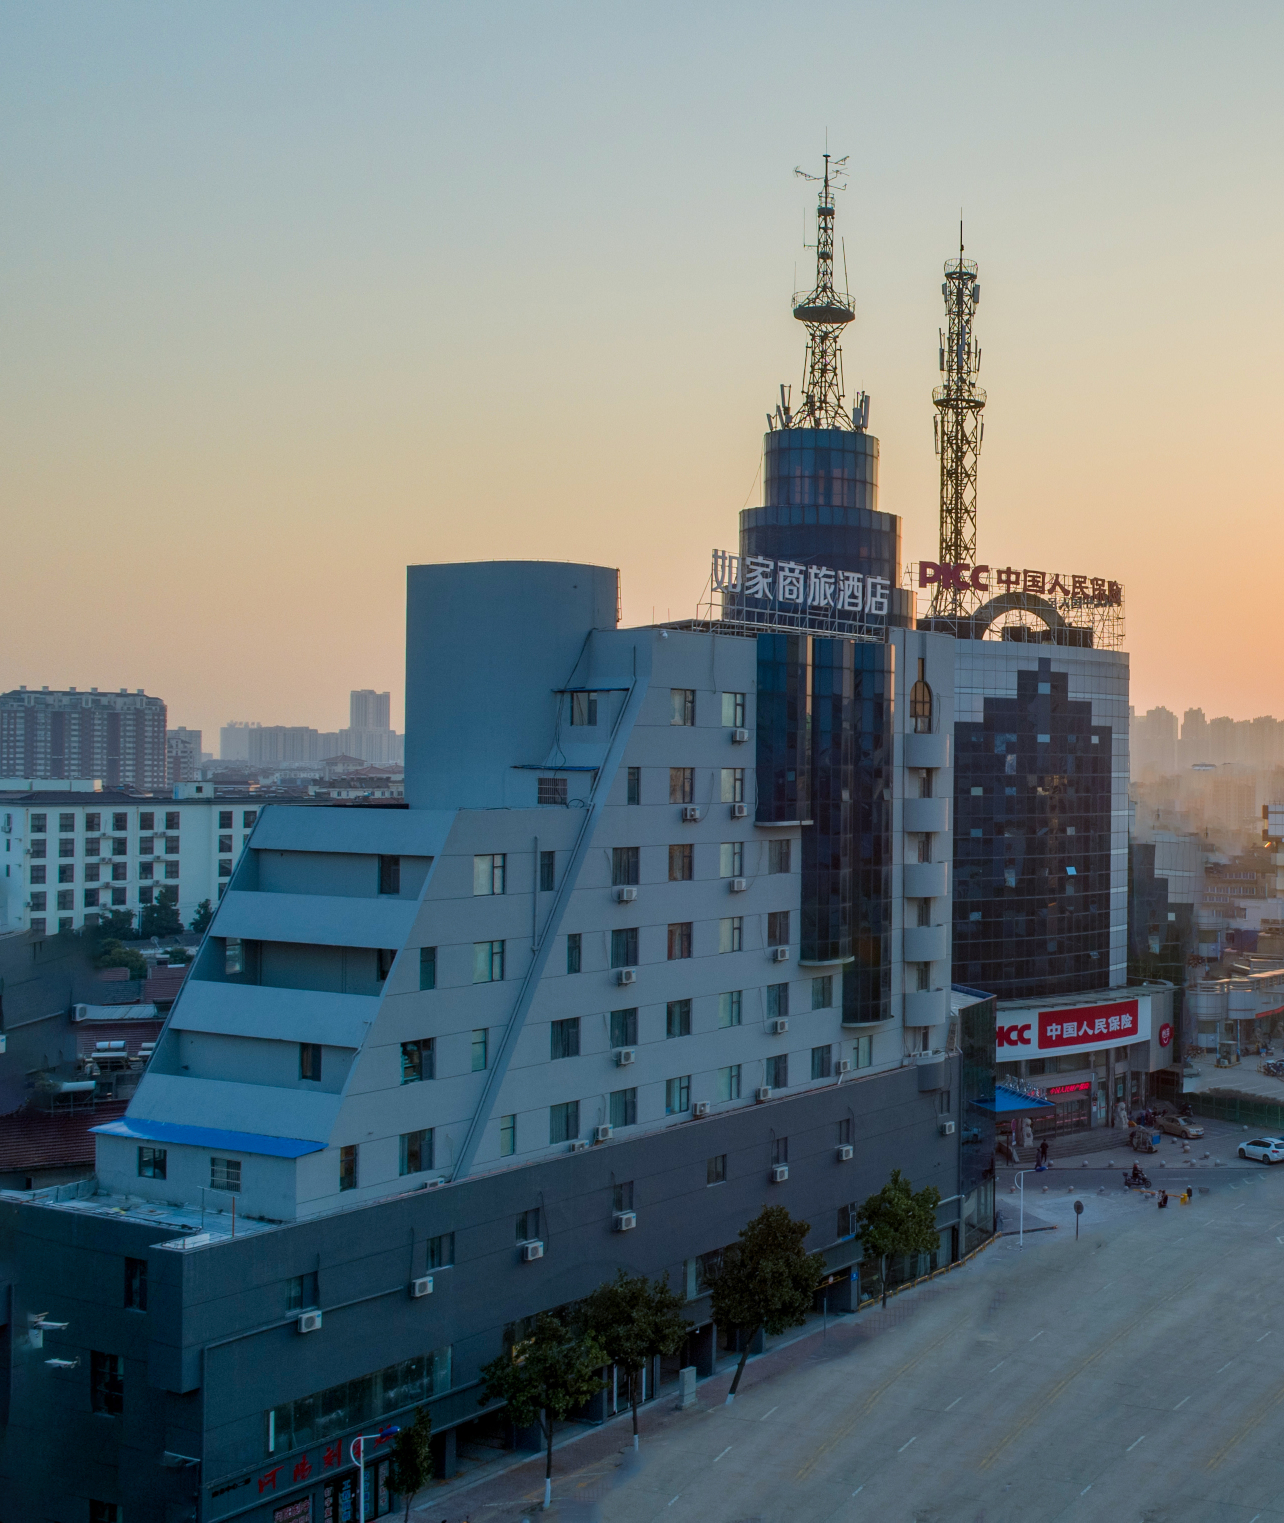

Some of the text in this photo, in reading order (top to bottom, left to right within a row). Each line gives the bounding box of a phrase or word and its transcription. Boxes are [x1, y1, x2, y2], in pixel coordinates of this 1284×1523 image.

[711, 549, 890, 615] 如家商旅酒店
[919, 561, 1122, 606] PICC 中国人民保险
[996, 1023, 1032, 1048] ICC
[1046, 1013, 1133, 1041] 中国人民保险
